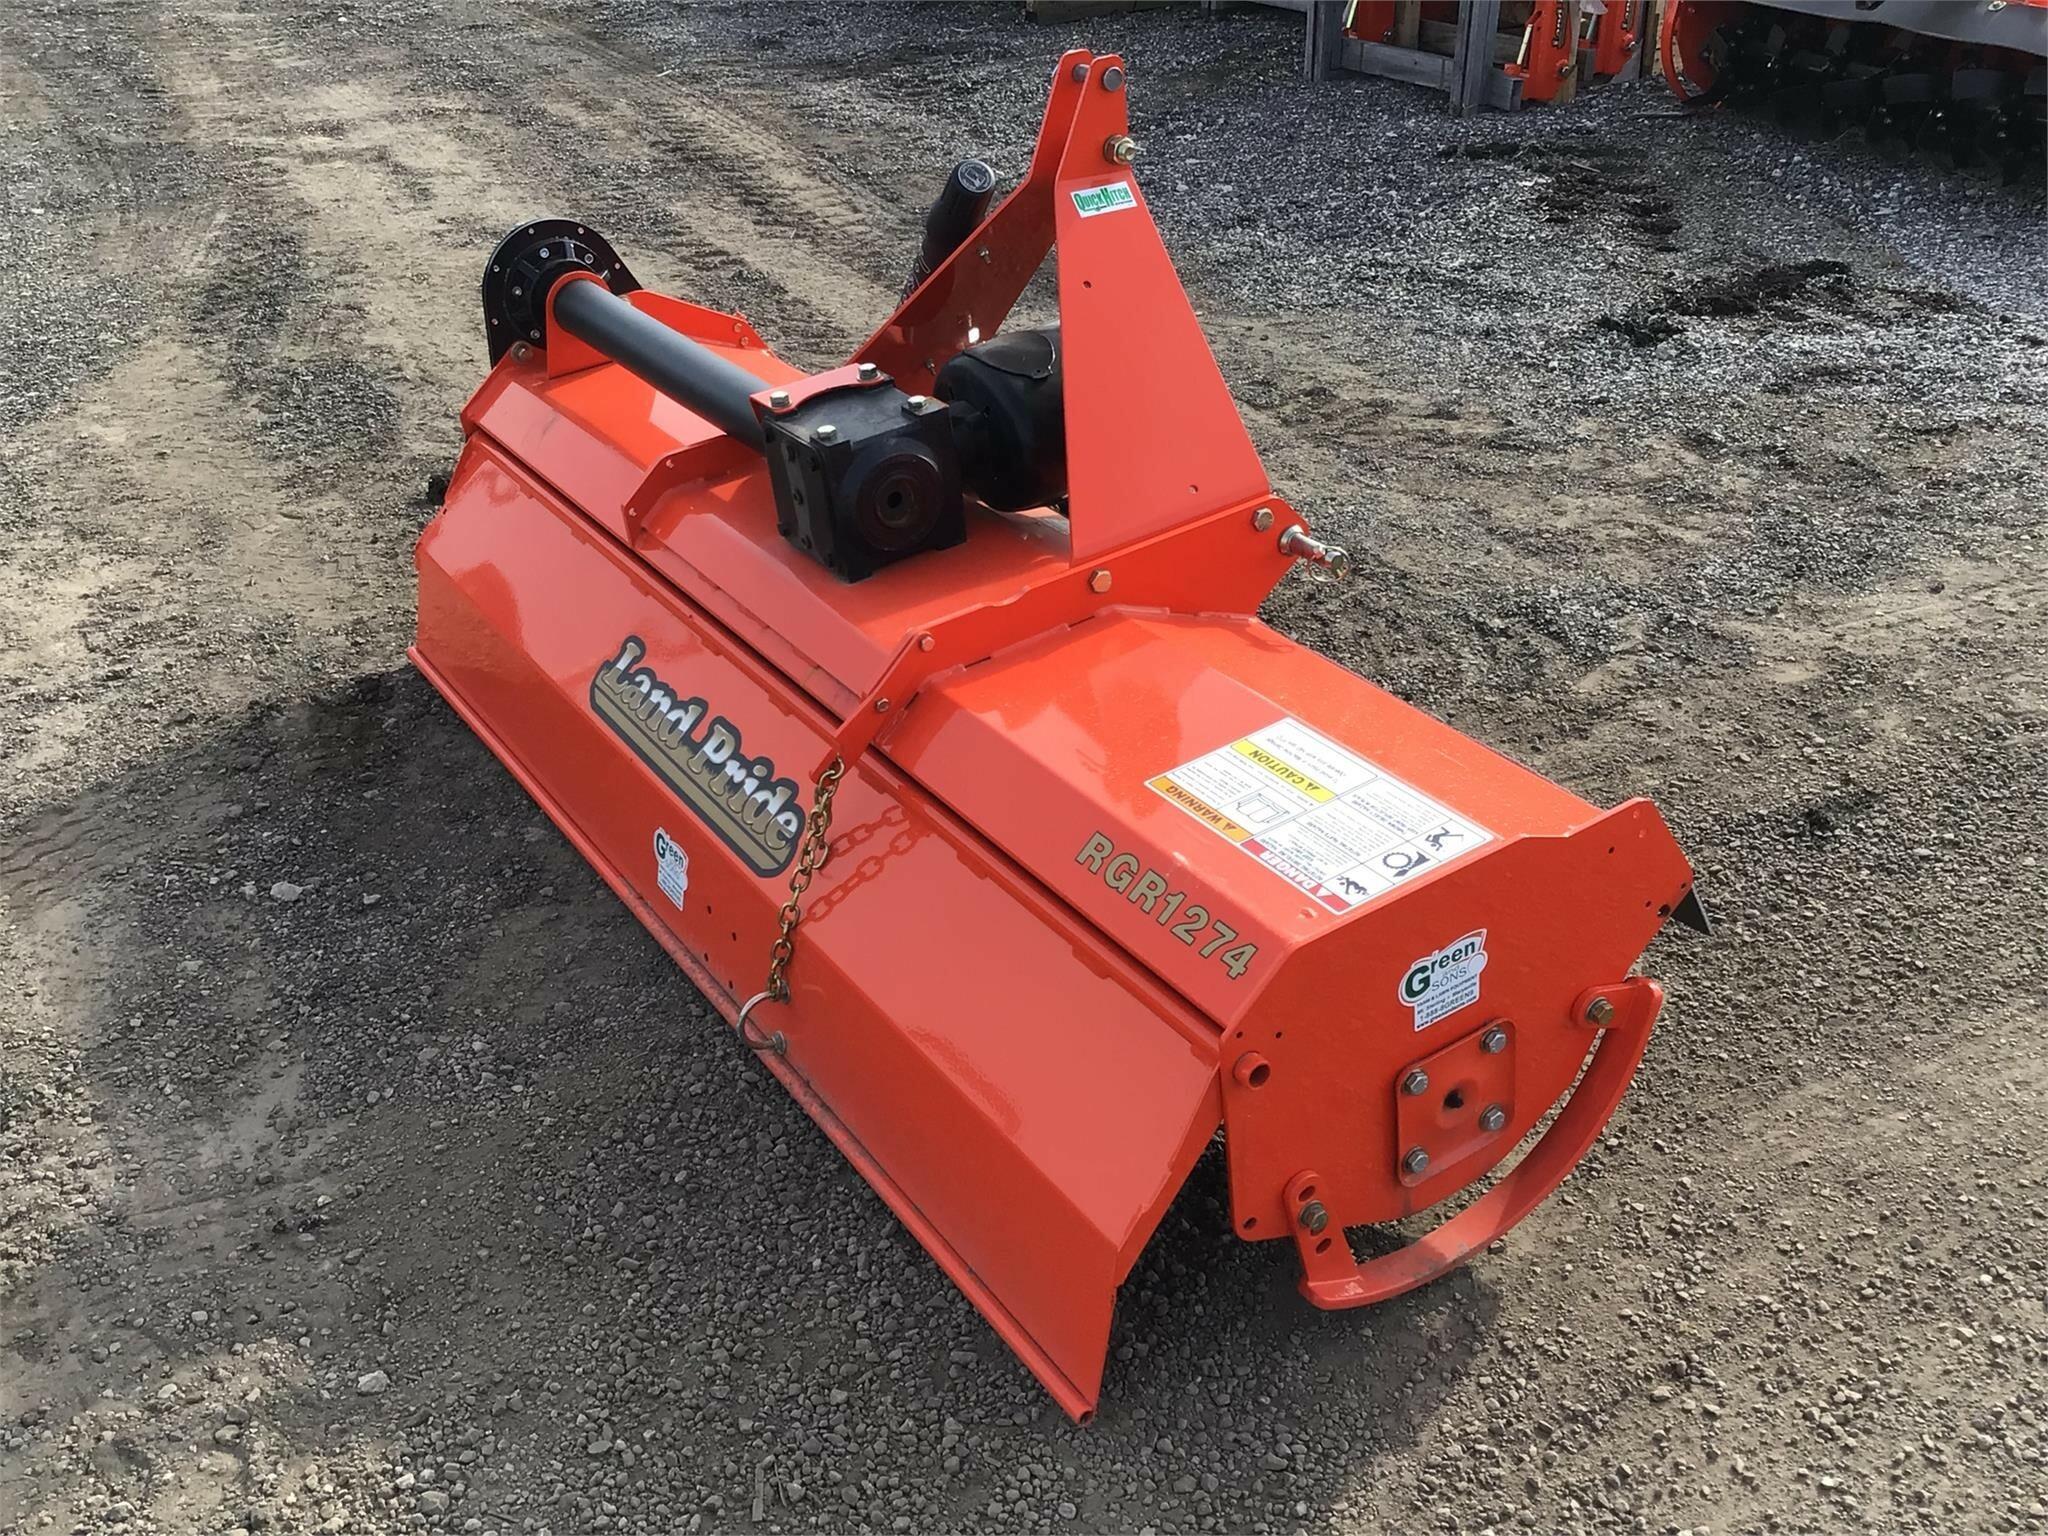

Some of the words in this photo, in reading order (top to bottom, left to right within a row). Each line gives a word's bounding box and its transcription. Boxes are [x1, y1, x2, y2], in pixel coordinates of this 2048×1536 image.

[601, 641, 704, 750] Land
[687, 723, 799, 850] Pride
[1246, 749, 1306, 784] CAUTION
[1163, 784, 1224, 823] WARNING
[656, 832, 684, 868] Green
[1256, 850, 1318, 889] DANGER
[1075, 831, 1258, 980] RGR1274
[1405, 941, 1476, 999] Green
[1432, 967, 1467, 991] SONS
